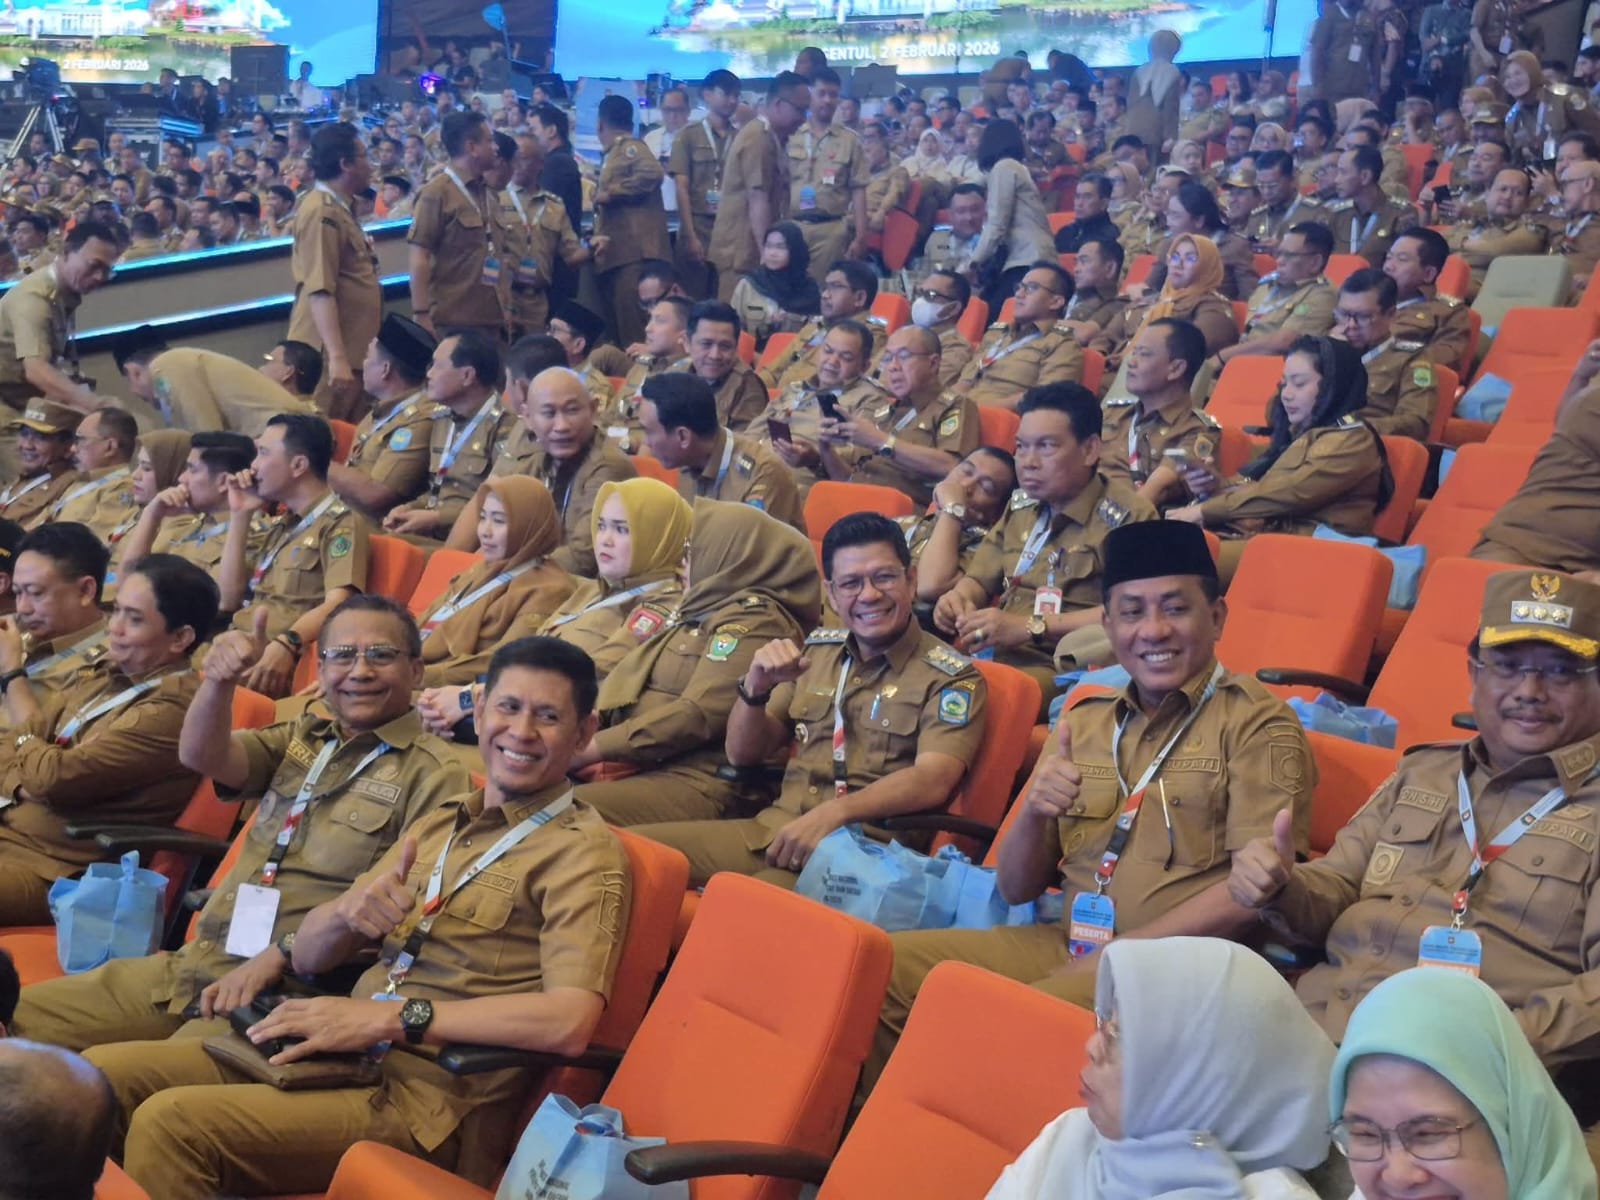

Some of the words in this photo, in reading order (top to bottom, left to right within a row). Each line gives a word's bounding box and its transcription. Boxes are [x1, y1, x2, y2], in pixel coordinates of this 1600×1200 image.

[824, 46, 876, 61] SENTUL,
[880, 45, 889, 59] 2
[895, 42, 960, 58] FEBRUARI
[965, 40, 1000, 56] 2026
[62, 59, 70, 70] 2
[123, 59, 150, 71] 2026
